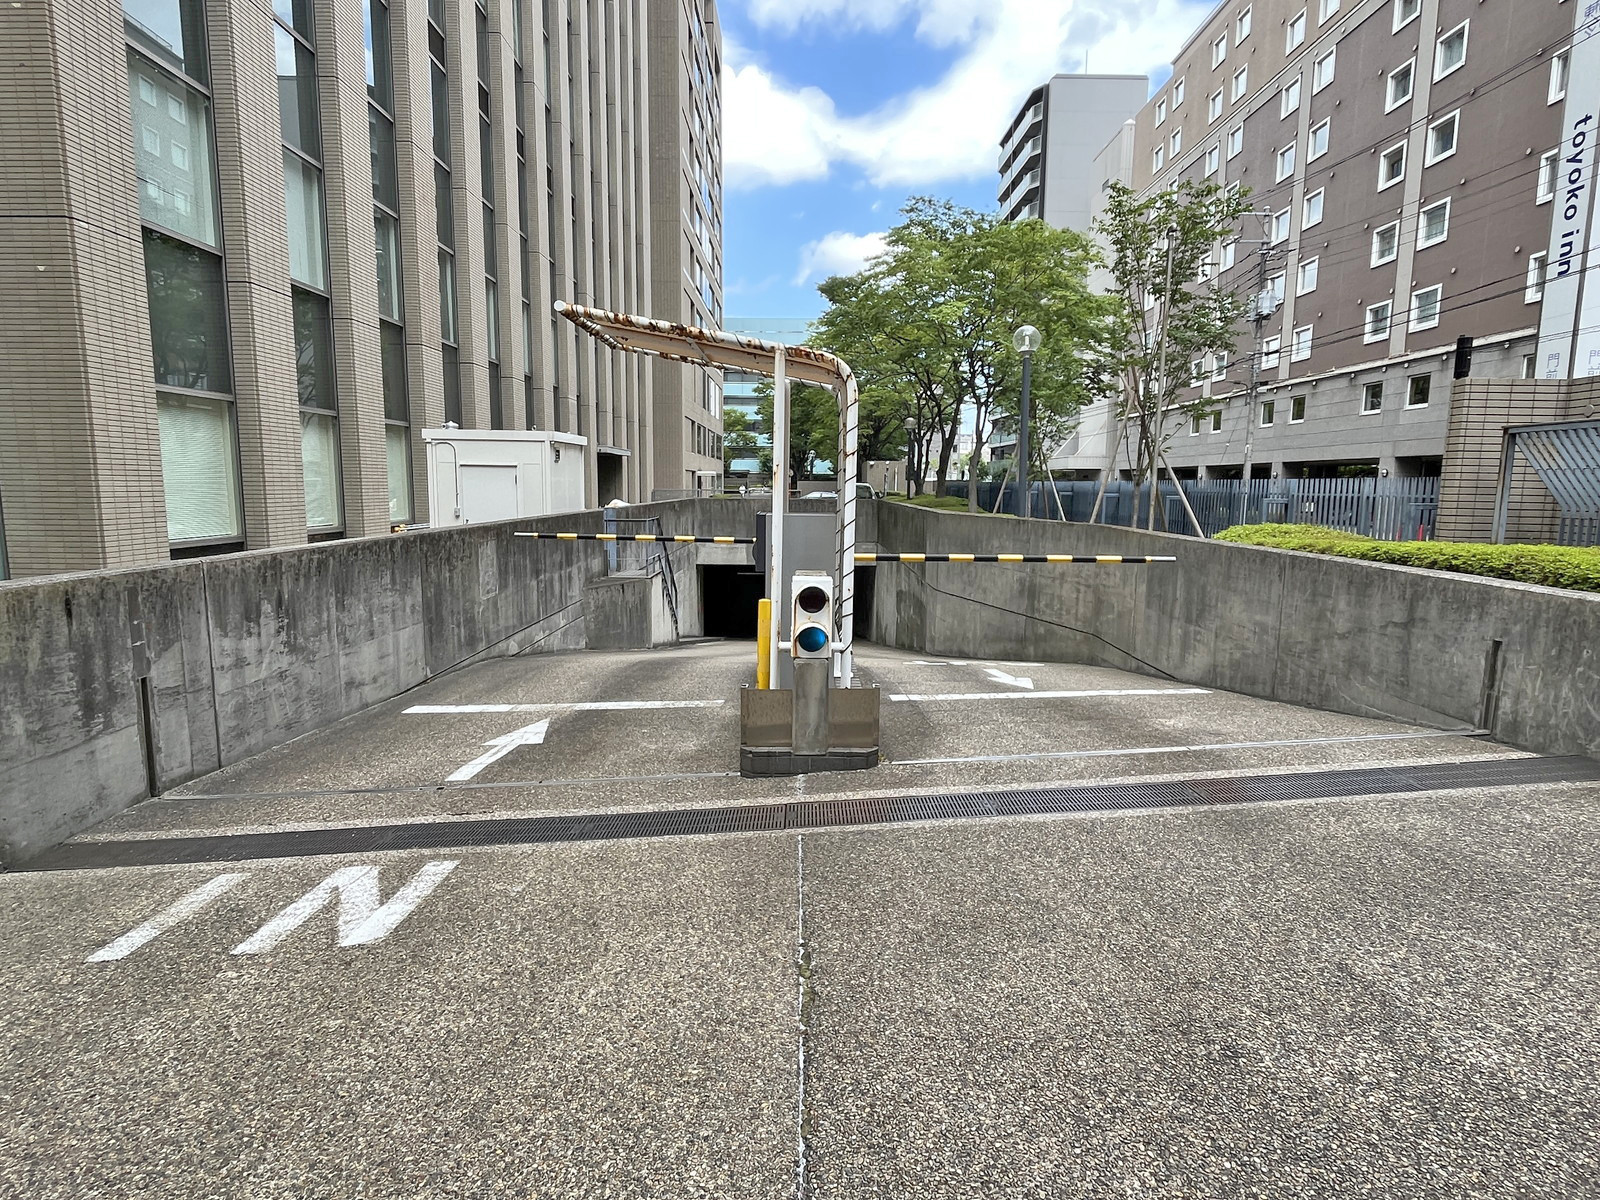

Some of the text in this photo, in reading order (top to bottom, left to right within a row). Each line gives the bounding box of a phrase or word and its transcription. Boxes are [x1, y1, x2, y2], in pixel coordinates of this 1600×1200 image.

[1558, 114, 1592, 276] toyoko inn
[85, 860, 461, 963] IN
